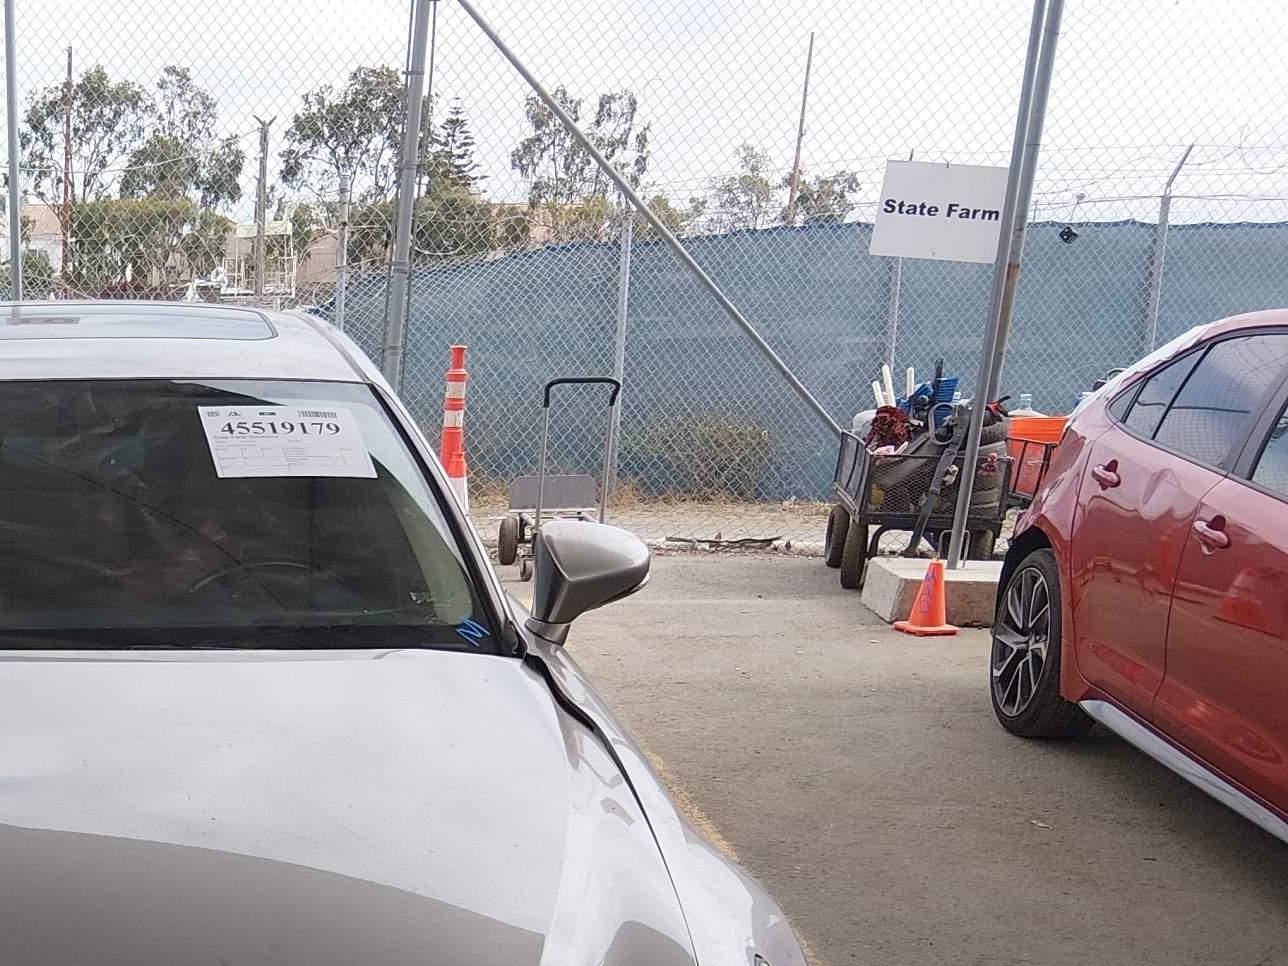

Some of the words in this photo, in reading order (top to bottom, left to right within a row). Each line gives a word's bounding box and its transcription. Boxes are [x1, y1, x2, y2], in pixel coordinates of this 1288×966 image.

[883, 199, 938, 216] State
[946, 203, 1000, 221] Farm
[220, 421, 341, 436] 45519179
